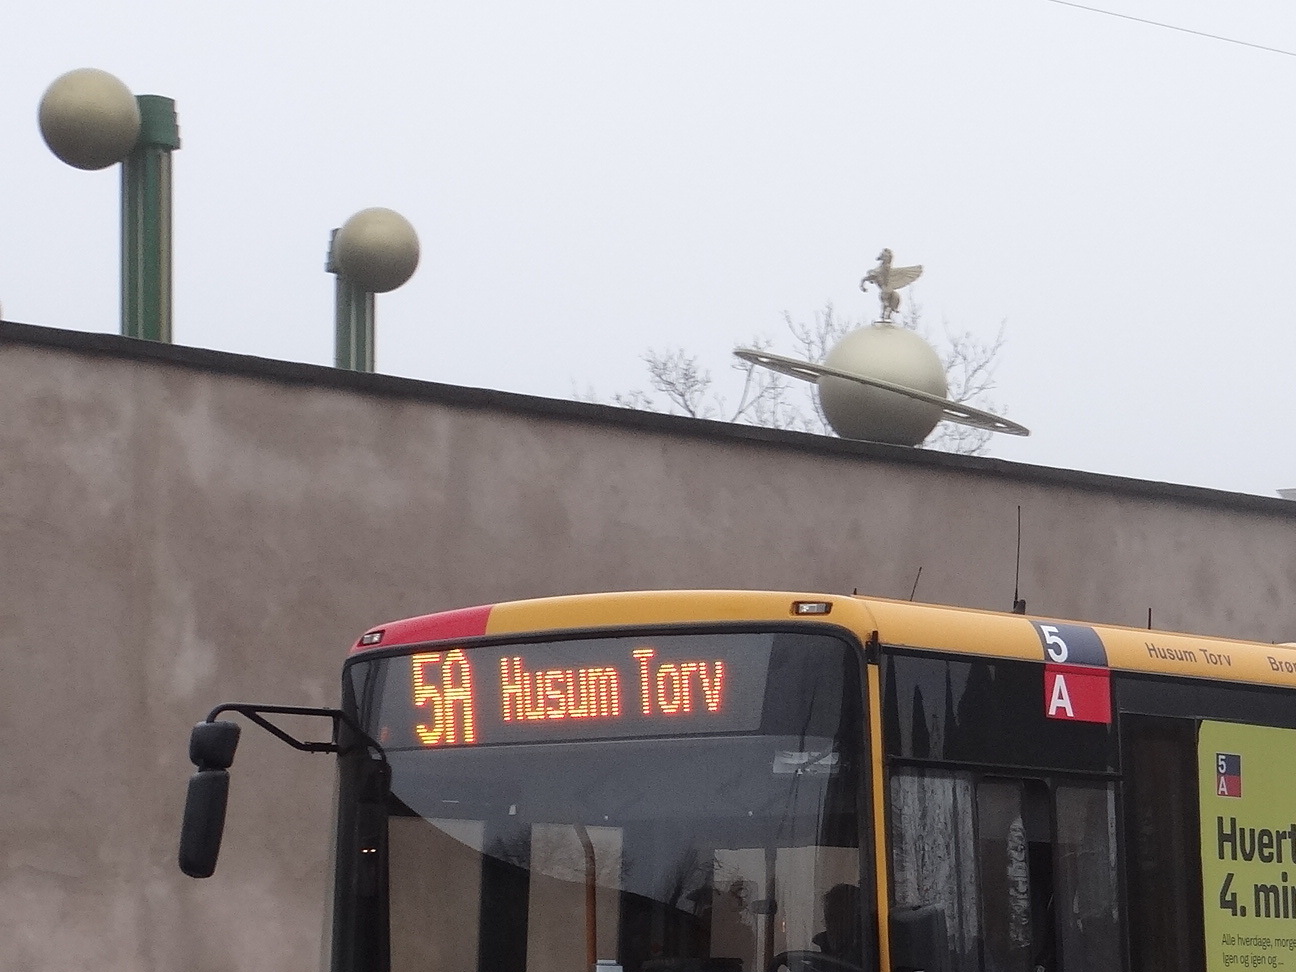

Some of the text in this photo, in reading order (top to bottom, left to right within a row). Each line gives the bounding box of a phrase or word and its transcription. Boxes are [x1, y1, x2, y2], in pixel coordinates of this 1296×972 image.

[1040, 625, 1068, 663] 5
[1145, 642, 1232, 667] Husum Torv
[412, 648, 724, 744] 5A Husum Torv
[1048, 674, 1074, 718] A
[1218, 755, 1227, 774] 5
[1218, 776, 1228, 795] A
[1219, 872, 1247, 917] 4.
[1222, 934, 1236, 946] Alle
[1237, 934, 1273, 950] hverdage,
[1222, 952, 1238, 967] Igen
[1240, 954, 1250, 968] og
[1250, 953, 1266, 968] igen
